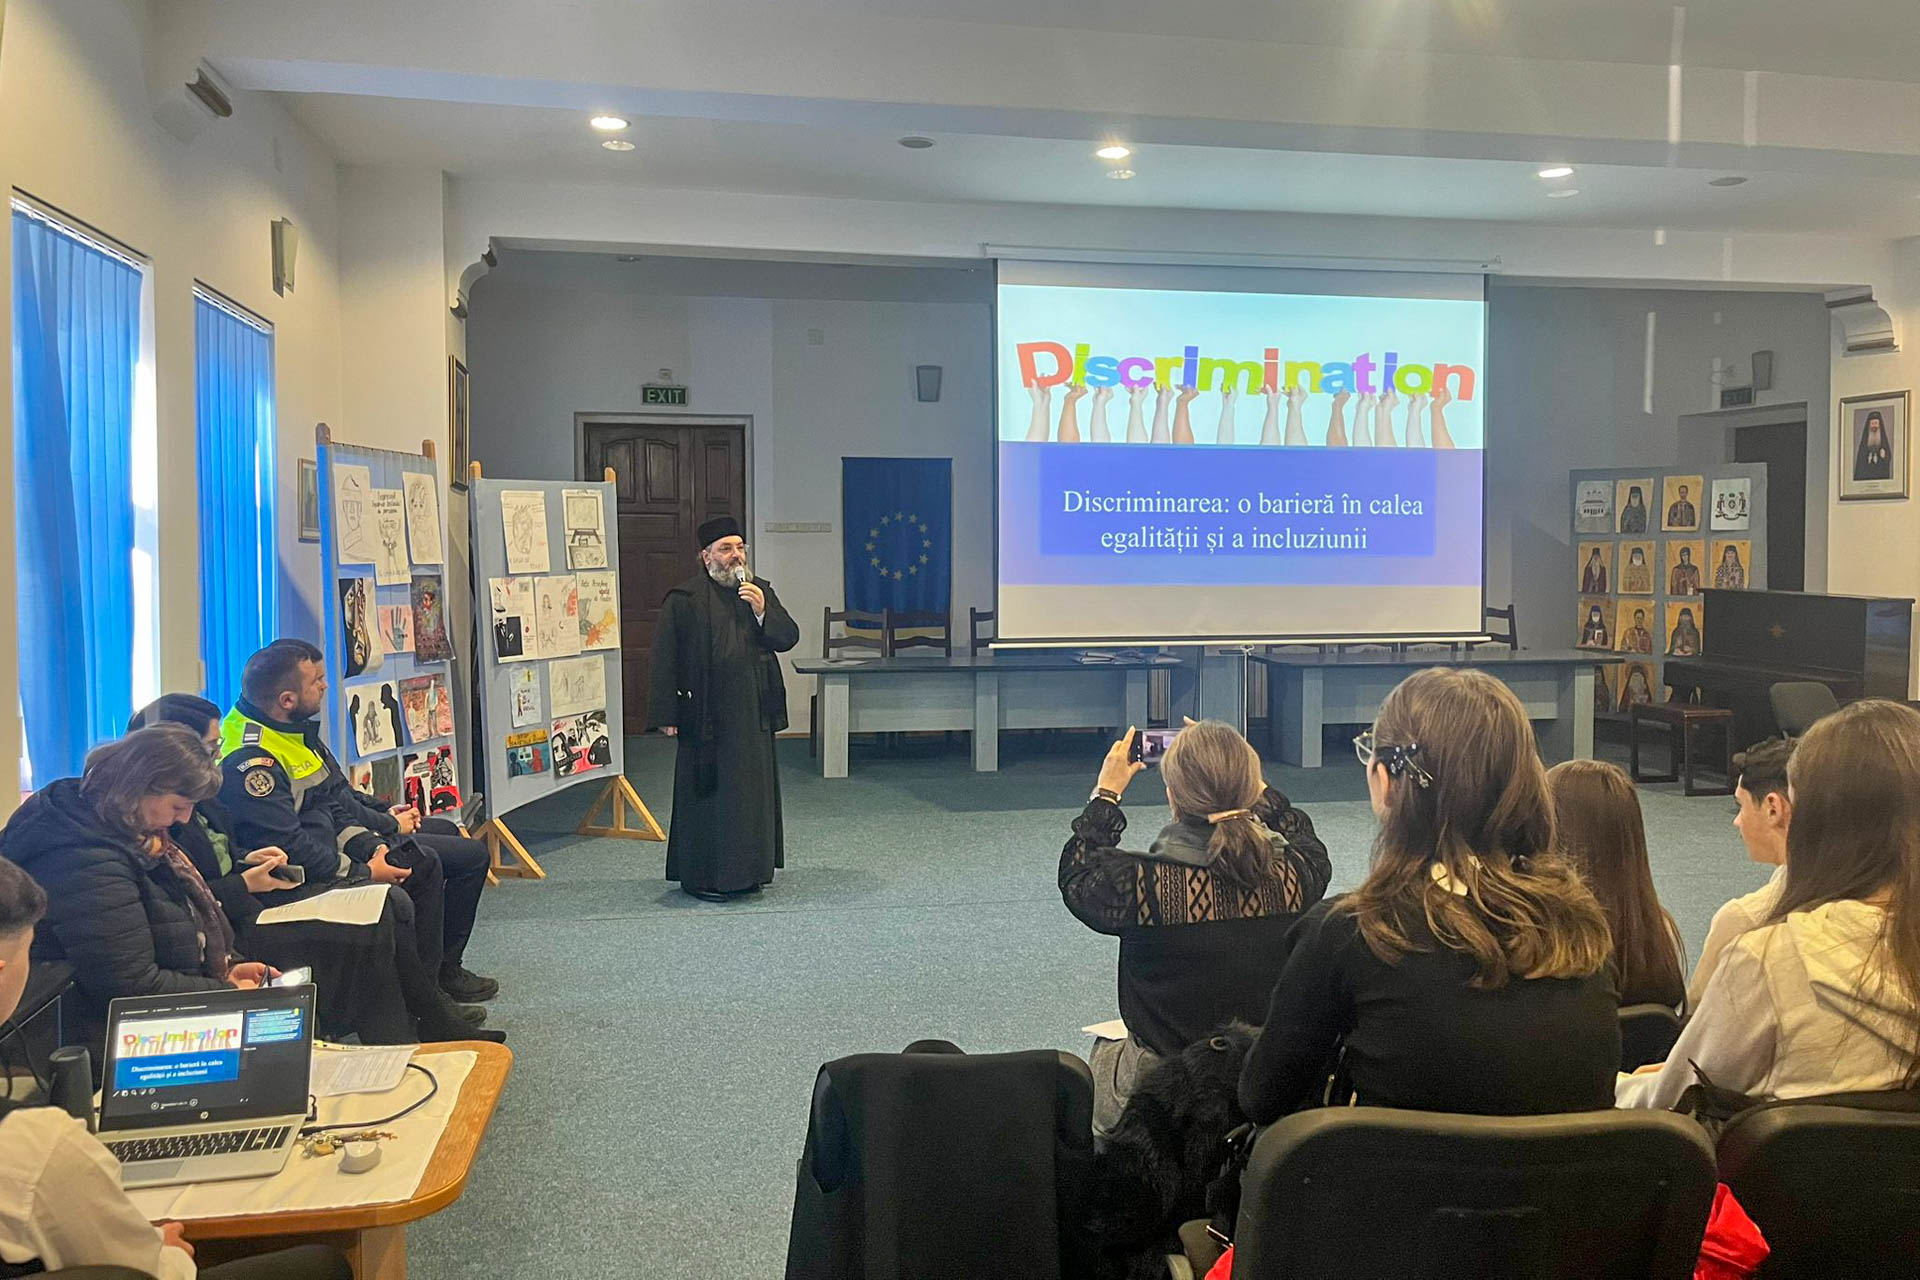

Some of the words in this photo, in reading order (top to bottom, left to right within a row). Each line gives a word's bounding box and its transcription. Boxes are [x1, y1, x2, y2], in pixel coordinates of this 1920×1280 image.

[1016, 341, 1475, 401] Discrimination
[647, 389, 681, 403] EXIT
[1063, 490, 1230, 514] Discriminarea:
[1238, 497, 1251, 514] o
[1259, 492, 1335, 514] barieră
[1341, 493, 1362, 514] în
[1369, 494, 1424, 515] calea
[1101, 526, 1199, 554] egalității
[1206, 526, 1224, 554] și
[1232, 532, 1244, 549] a
[1252, 527, 1367, 549] incluziunii
